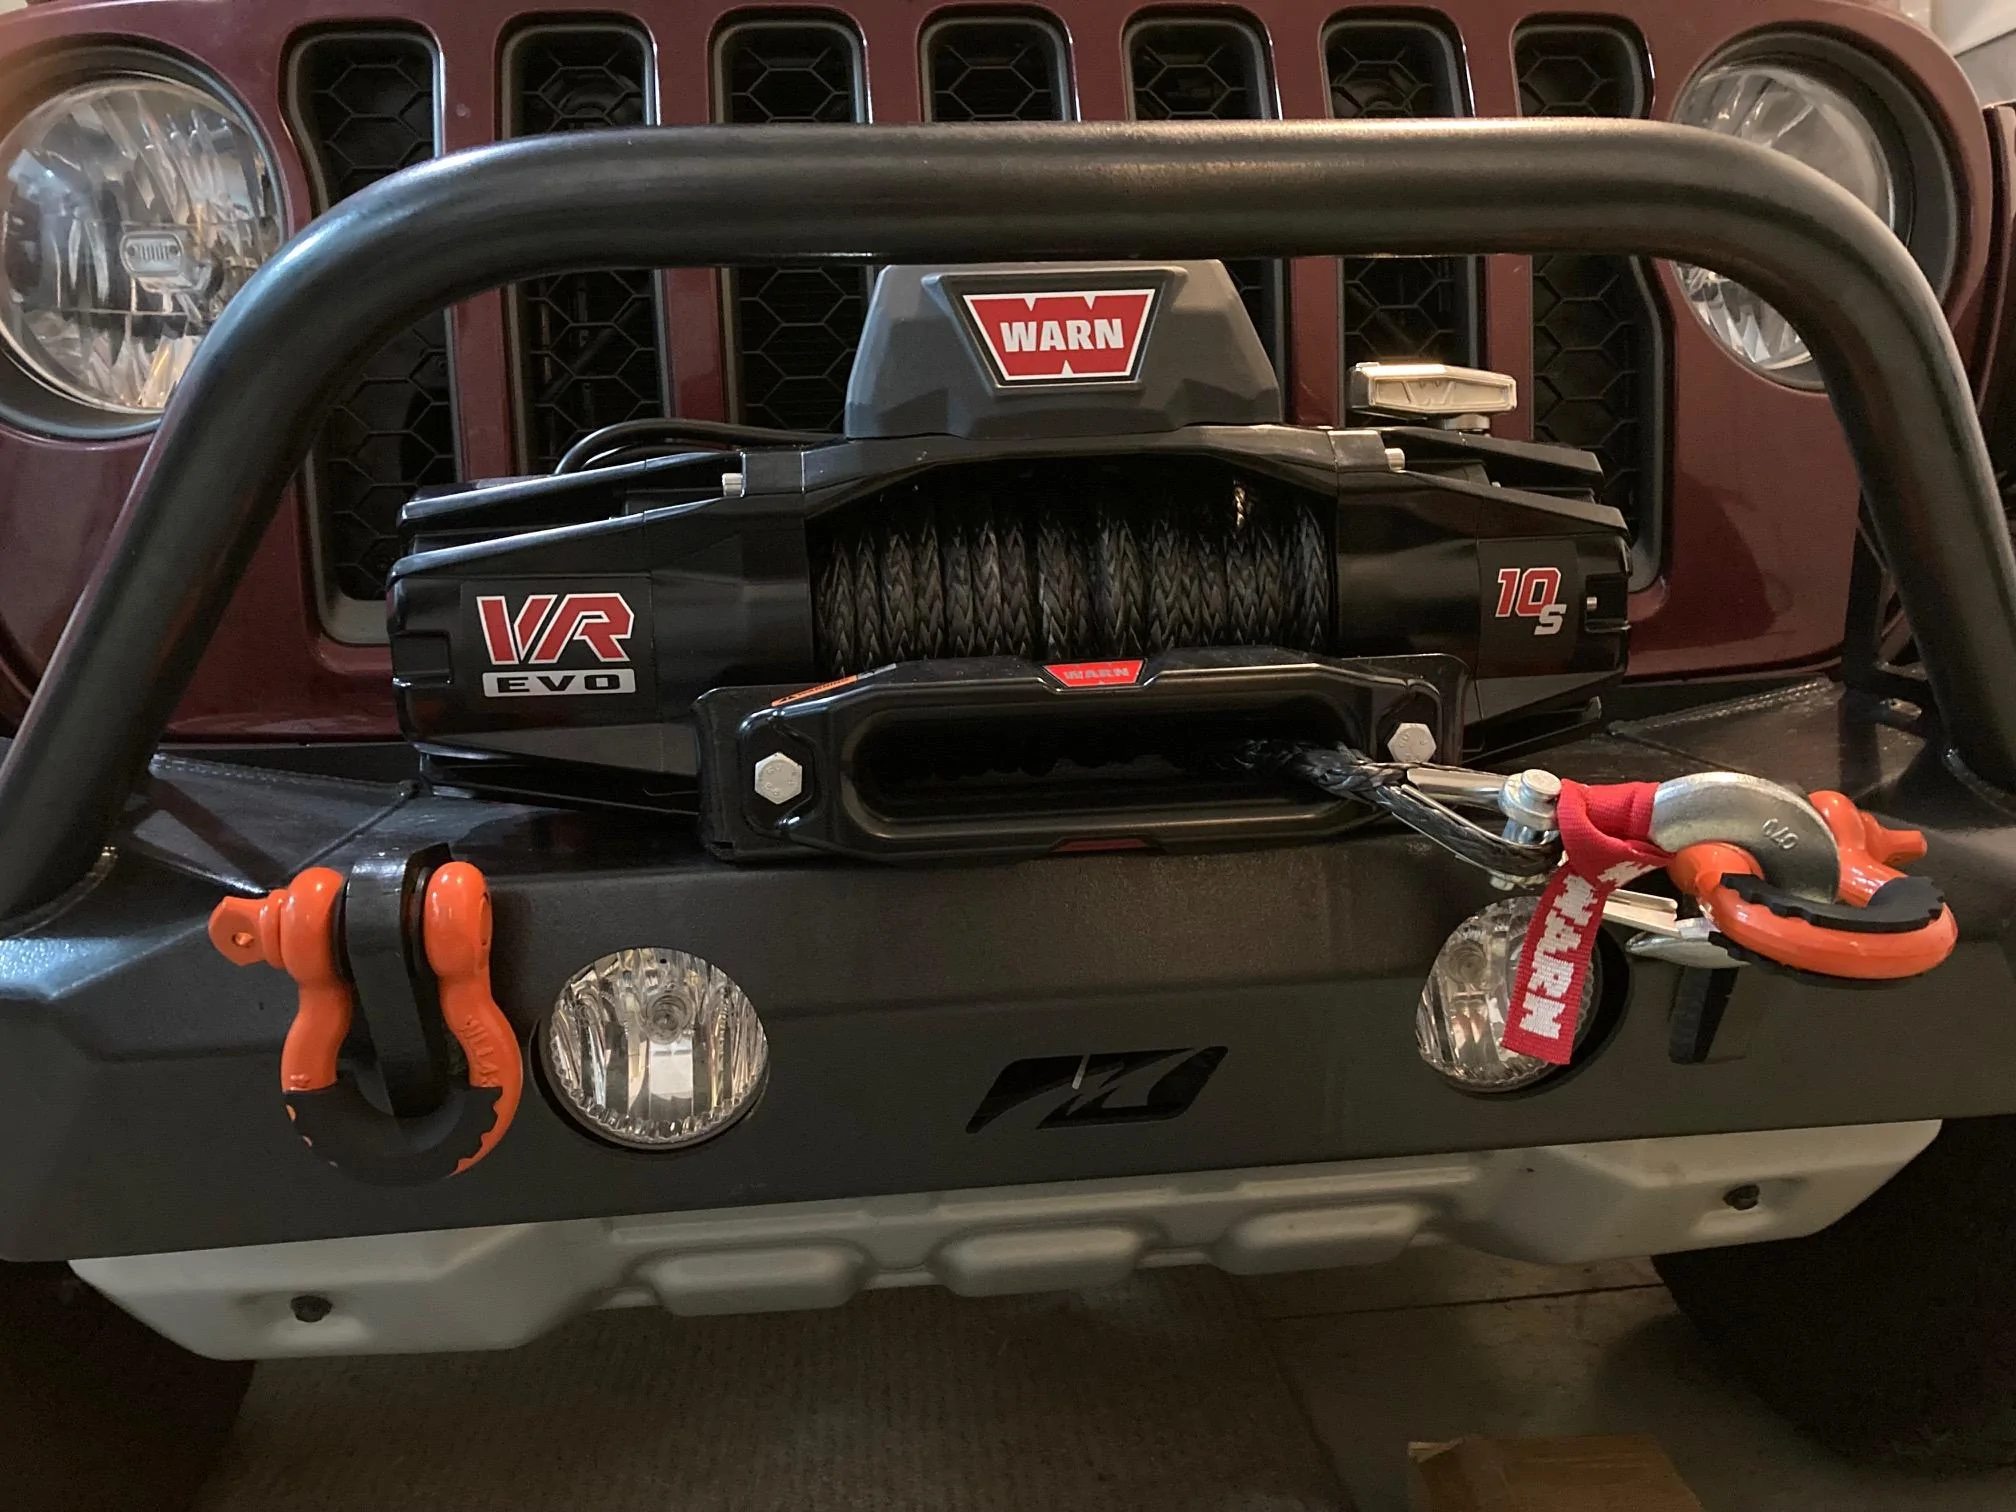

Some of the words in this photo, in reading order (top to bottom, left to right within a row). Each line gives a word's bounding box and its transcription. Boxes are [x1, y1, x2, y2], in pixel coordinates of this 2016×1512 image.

[1000, 318, 1125, 352] WARN
[476, 593, 635, 665] VR
[497, 674, 621, 693] EVO
[1063, 667, 1130, 680] WARN
[1519, 874, 1599, 1040] WARN
